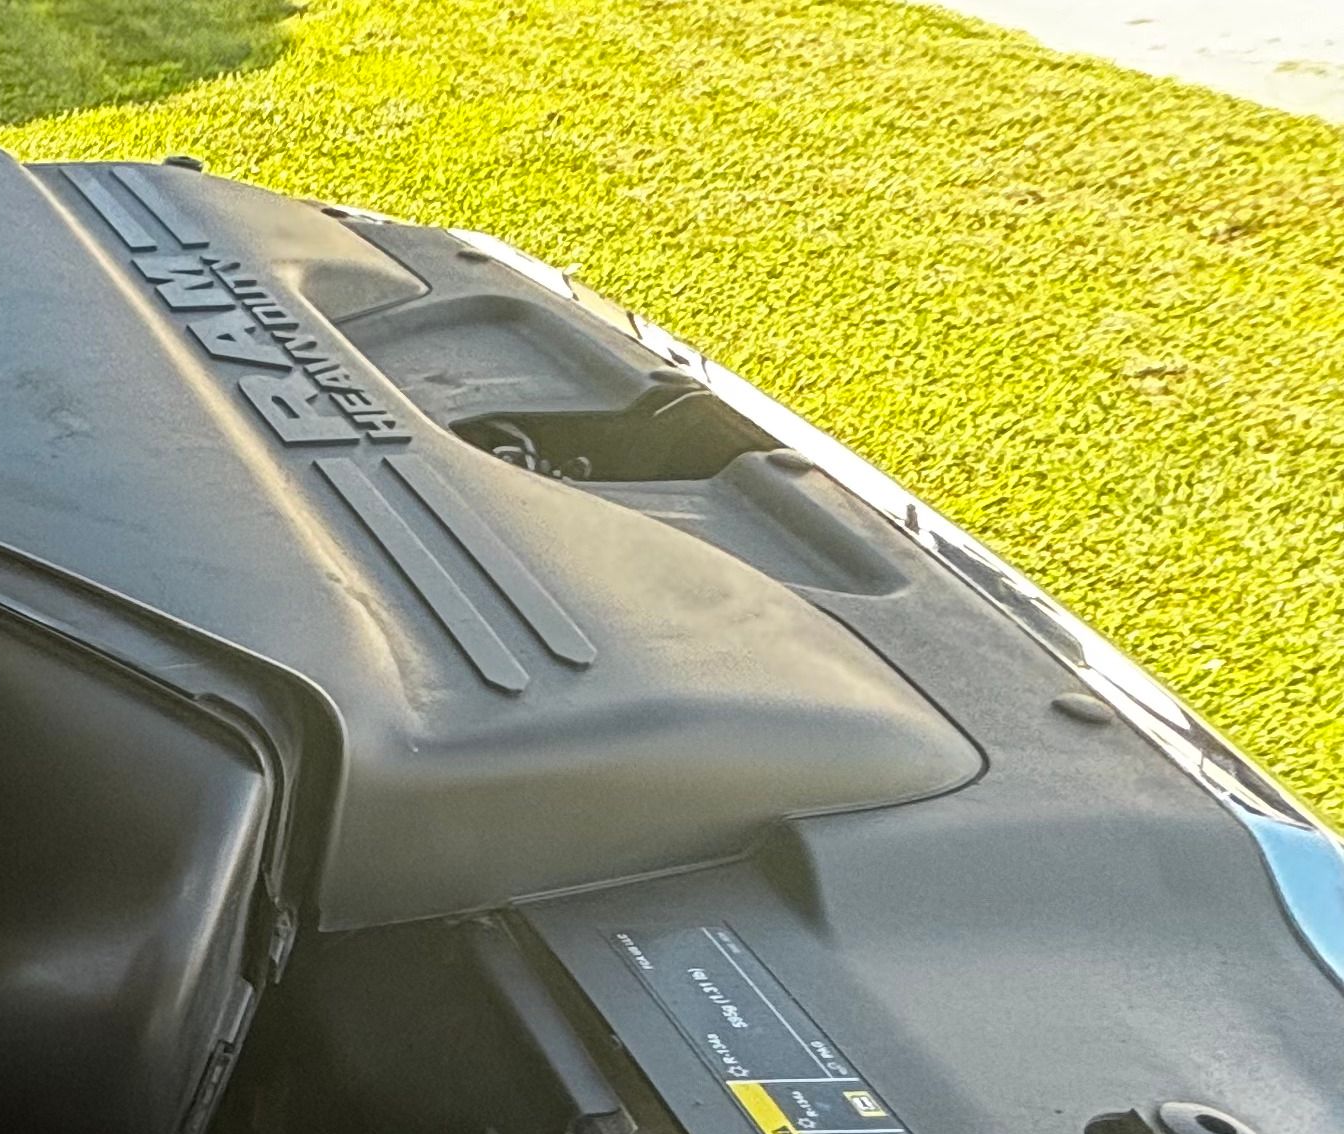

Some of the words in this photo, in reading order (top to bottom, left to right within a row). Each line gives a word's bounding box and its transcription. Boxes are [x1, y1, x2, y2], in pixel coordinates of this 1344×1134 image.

[200, 256, 300, 330] DUTY
[132, 256, 361, 447] RAM
[270, 331, 413, 444] HEAVY
